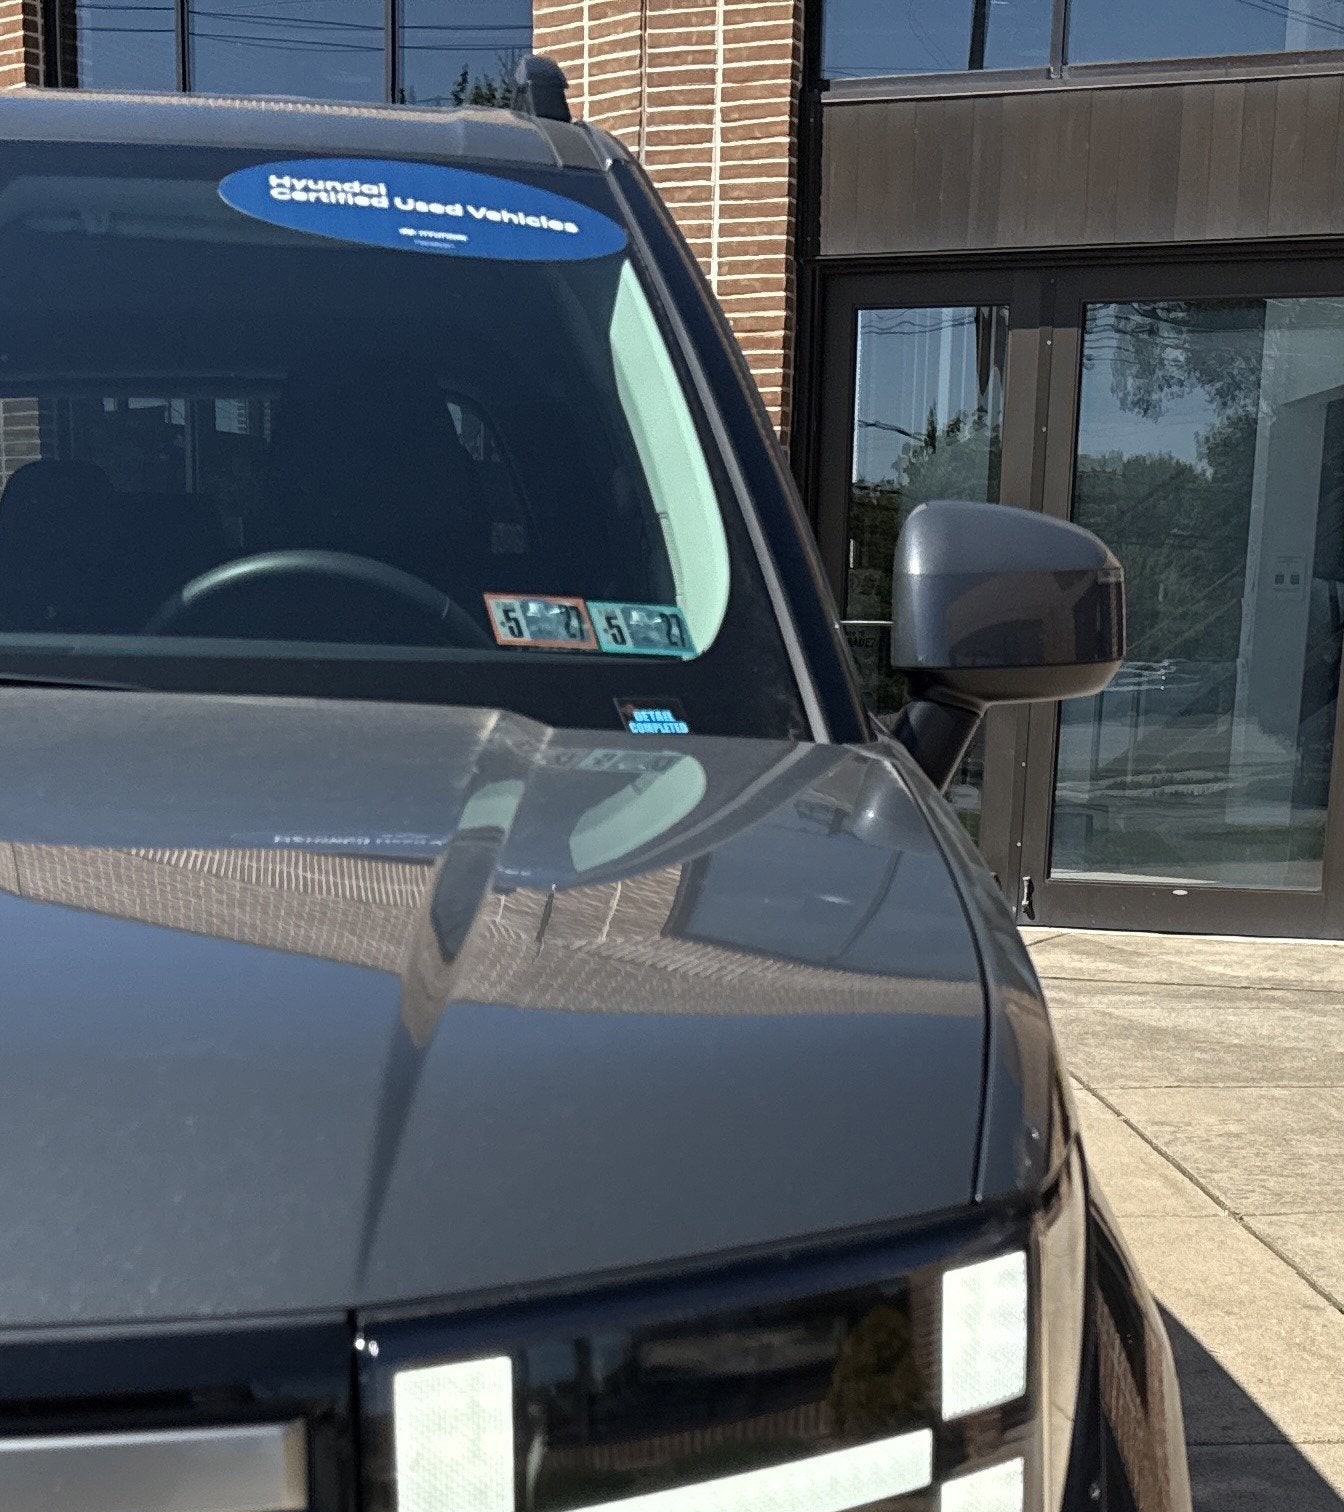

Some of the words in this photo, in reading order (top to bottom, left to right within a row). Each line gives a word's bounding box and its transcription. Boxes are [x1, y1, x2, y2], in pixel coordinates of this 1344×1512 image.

[268, 174, 387, 196] Hyundai
[269, 187, 389, 209] Certified
[394, 196, 463, 217] Used
[467, 204, 580, 234] Vehicles
[502, 608, 524, 639] 5
[604, 615, 627, 646] 5
[629, 721, 689, 734] COMPLETED
